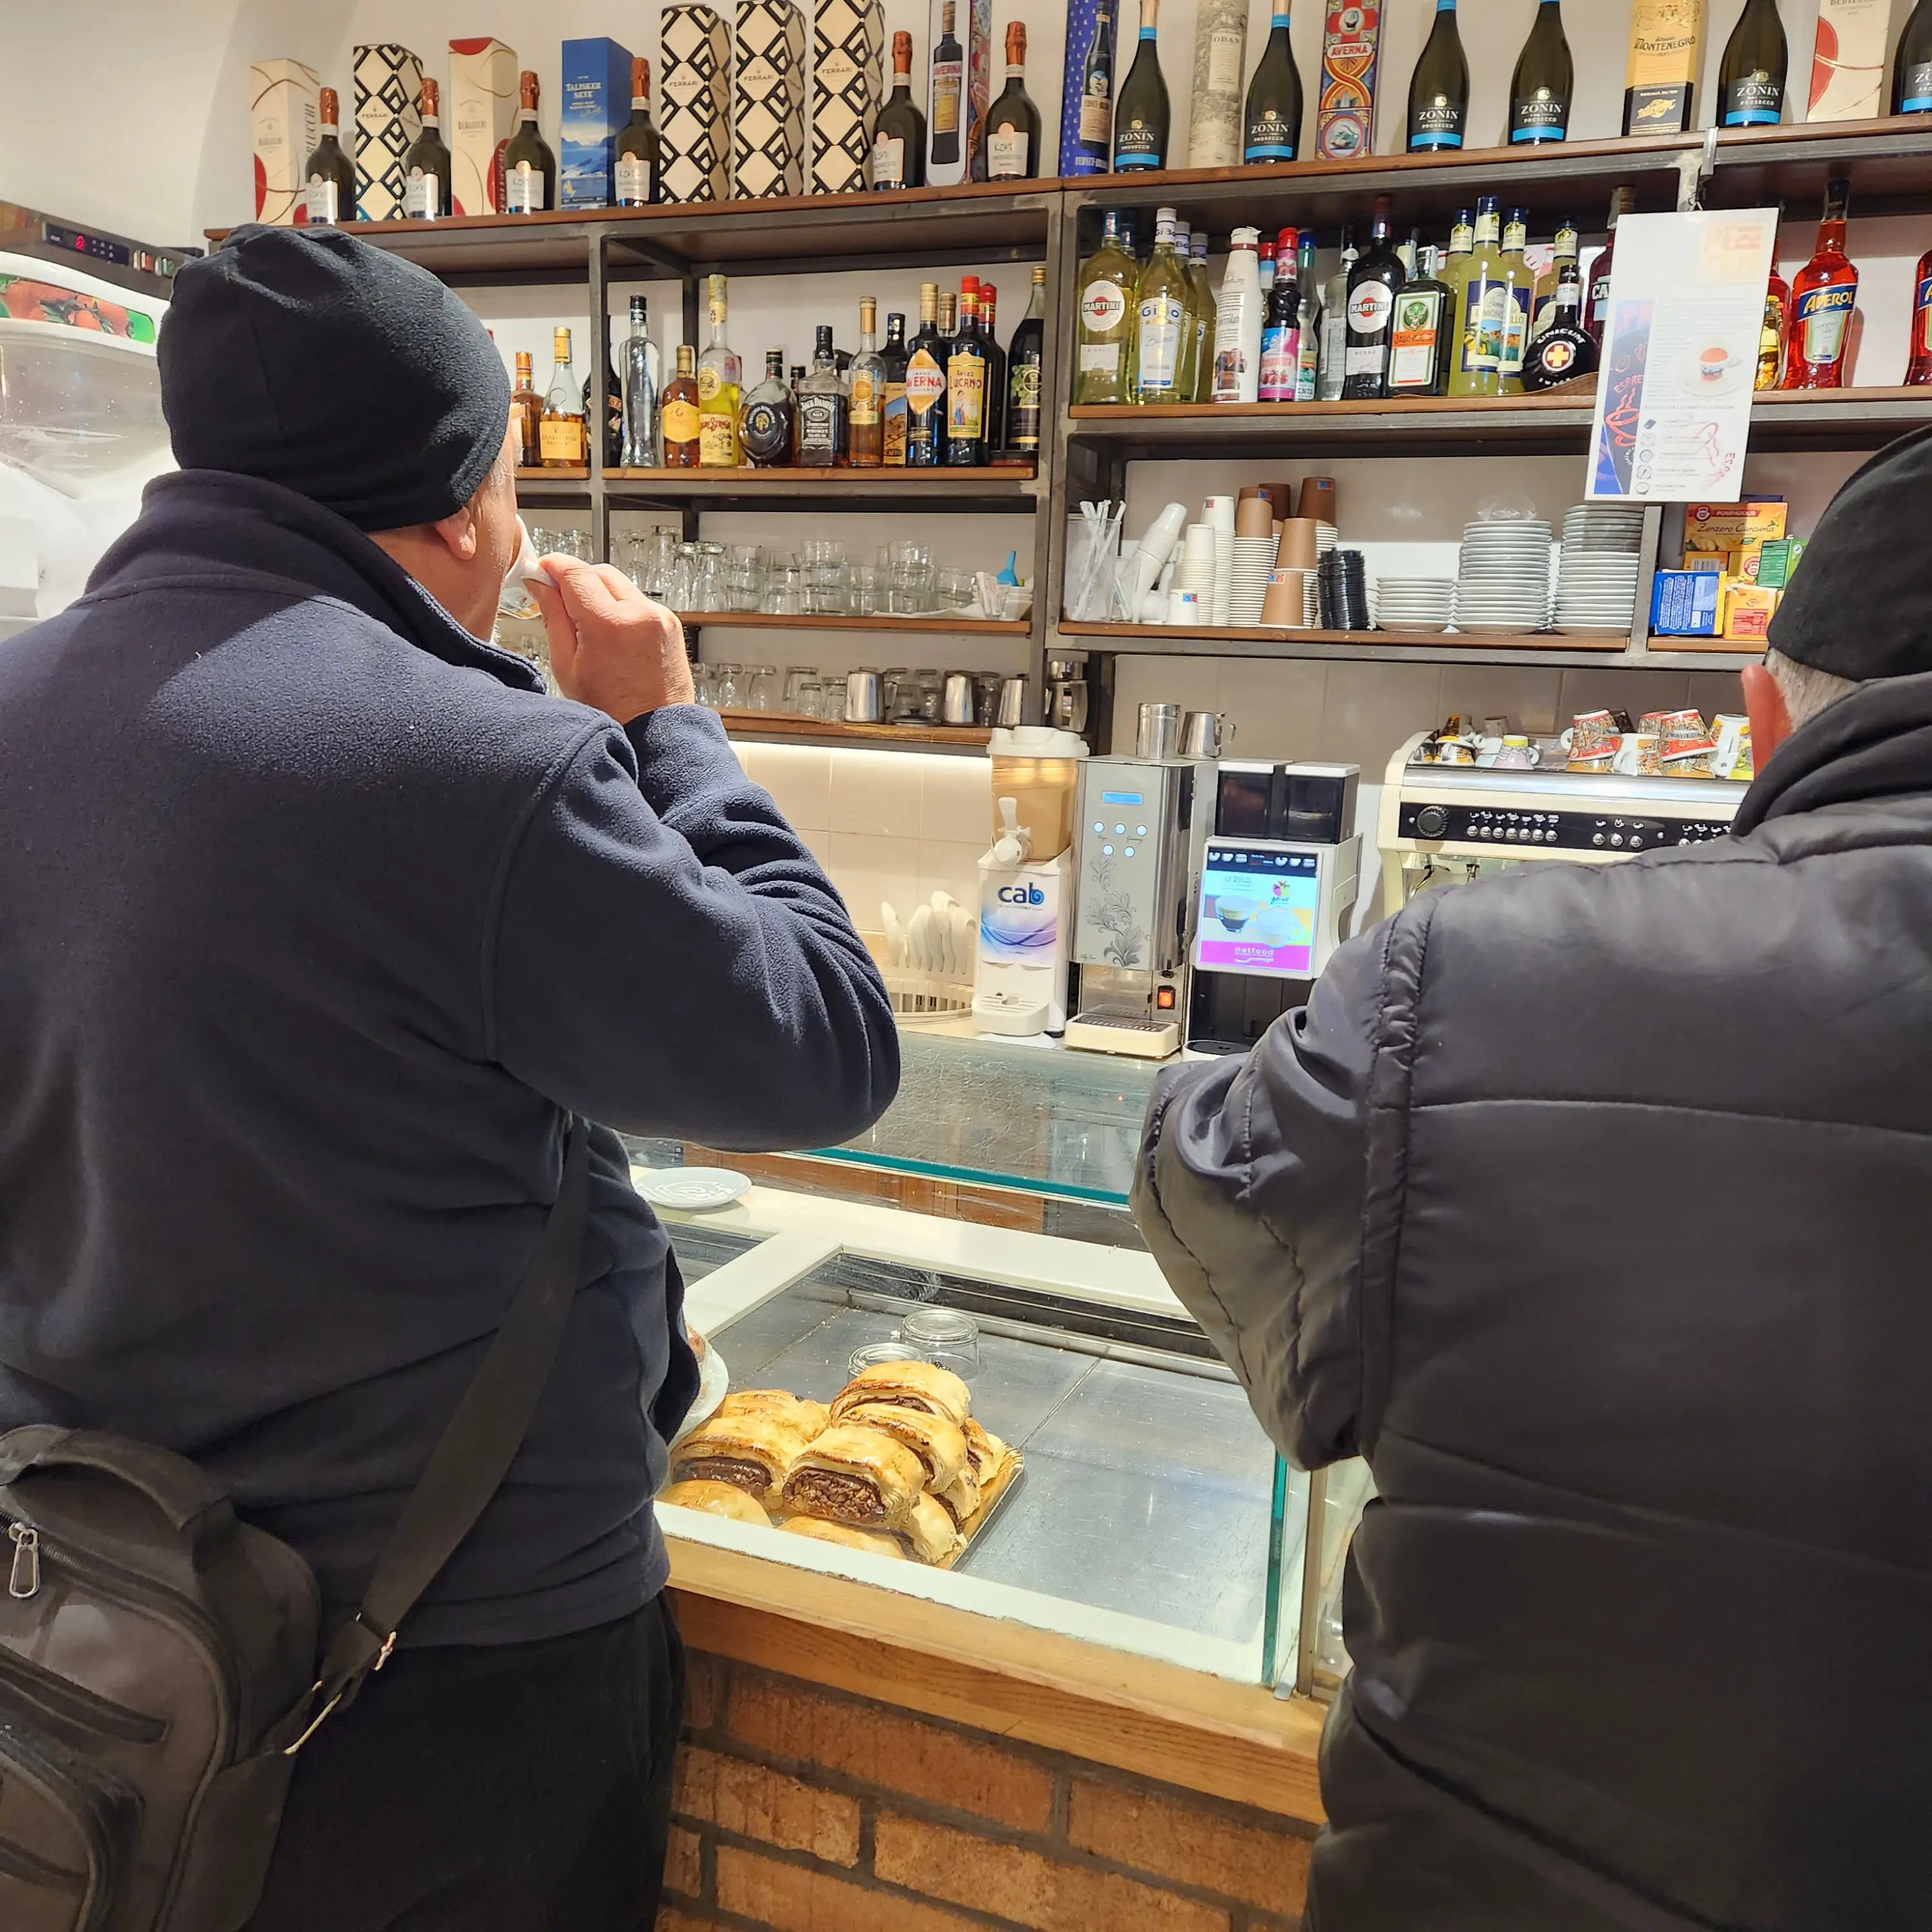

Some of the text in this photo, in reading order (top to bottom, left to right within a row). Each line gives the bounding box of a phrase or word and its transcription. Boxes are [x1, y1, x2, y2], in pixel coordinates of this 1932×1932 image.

[1213, 36, 1240, 44] OBAN
[1634, 36, 1696, 50] MONTENEGRO
[1331, 45, 1368, 56] AVERNA
[821, 67, 853, 75] FERRARI
[1736, 86, 1780, 97] ZONIN
[1521, 103, 1563, 115] ZONIN
[1419, 110, 1459, 121] ZONIN
[1251, 123, 1289, 134] ZONIN
[1118, 132, 1155, 143] ZONIN
[1084, 301, 1120, 311] MARTINI
[1351, 302, 1389, 314] MARTINI
[1803, 291, 1854, 314] APEROL
[1536, 328, 1587, 344] UNICUM
[949, 376, 982, 389] LUCANO
[1696, 522, 1774, 533] Zenzero Curcuma
[998, 882, 1045, 905] cab
[1234, 947, 1274, 955] natfood
